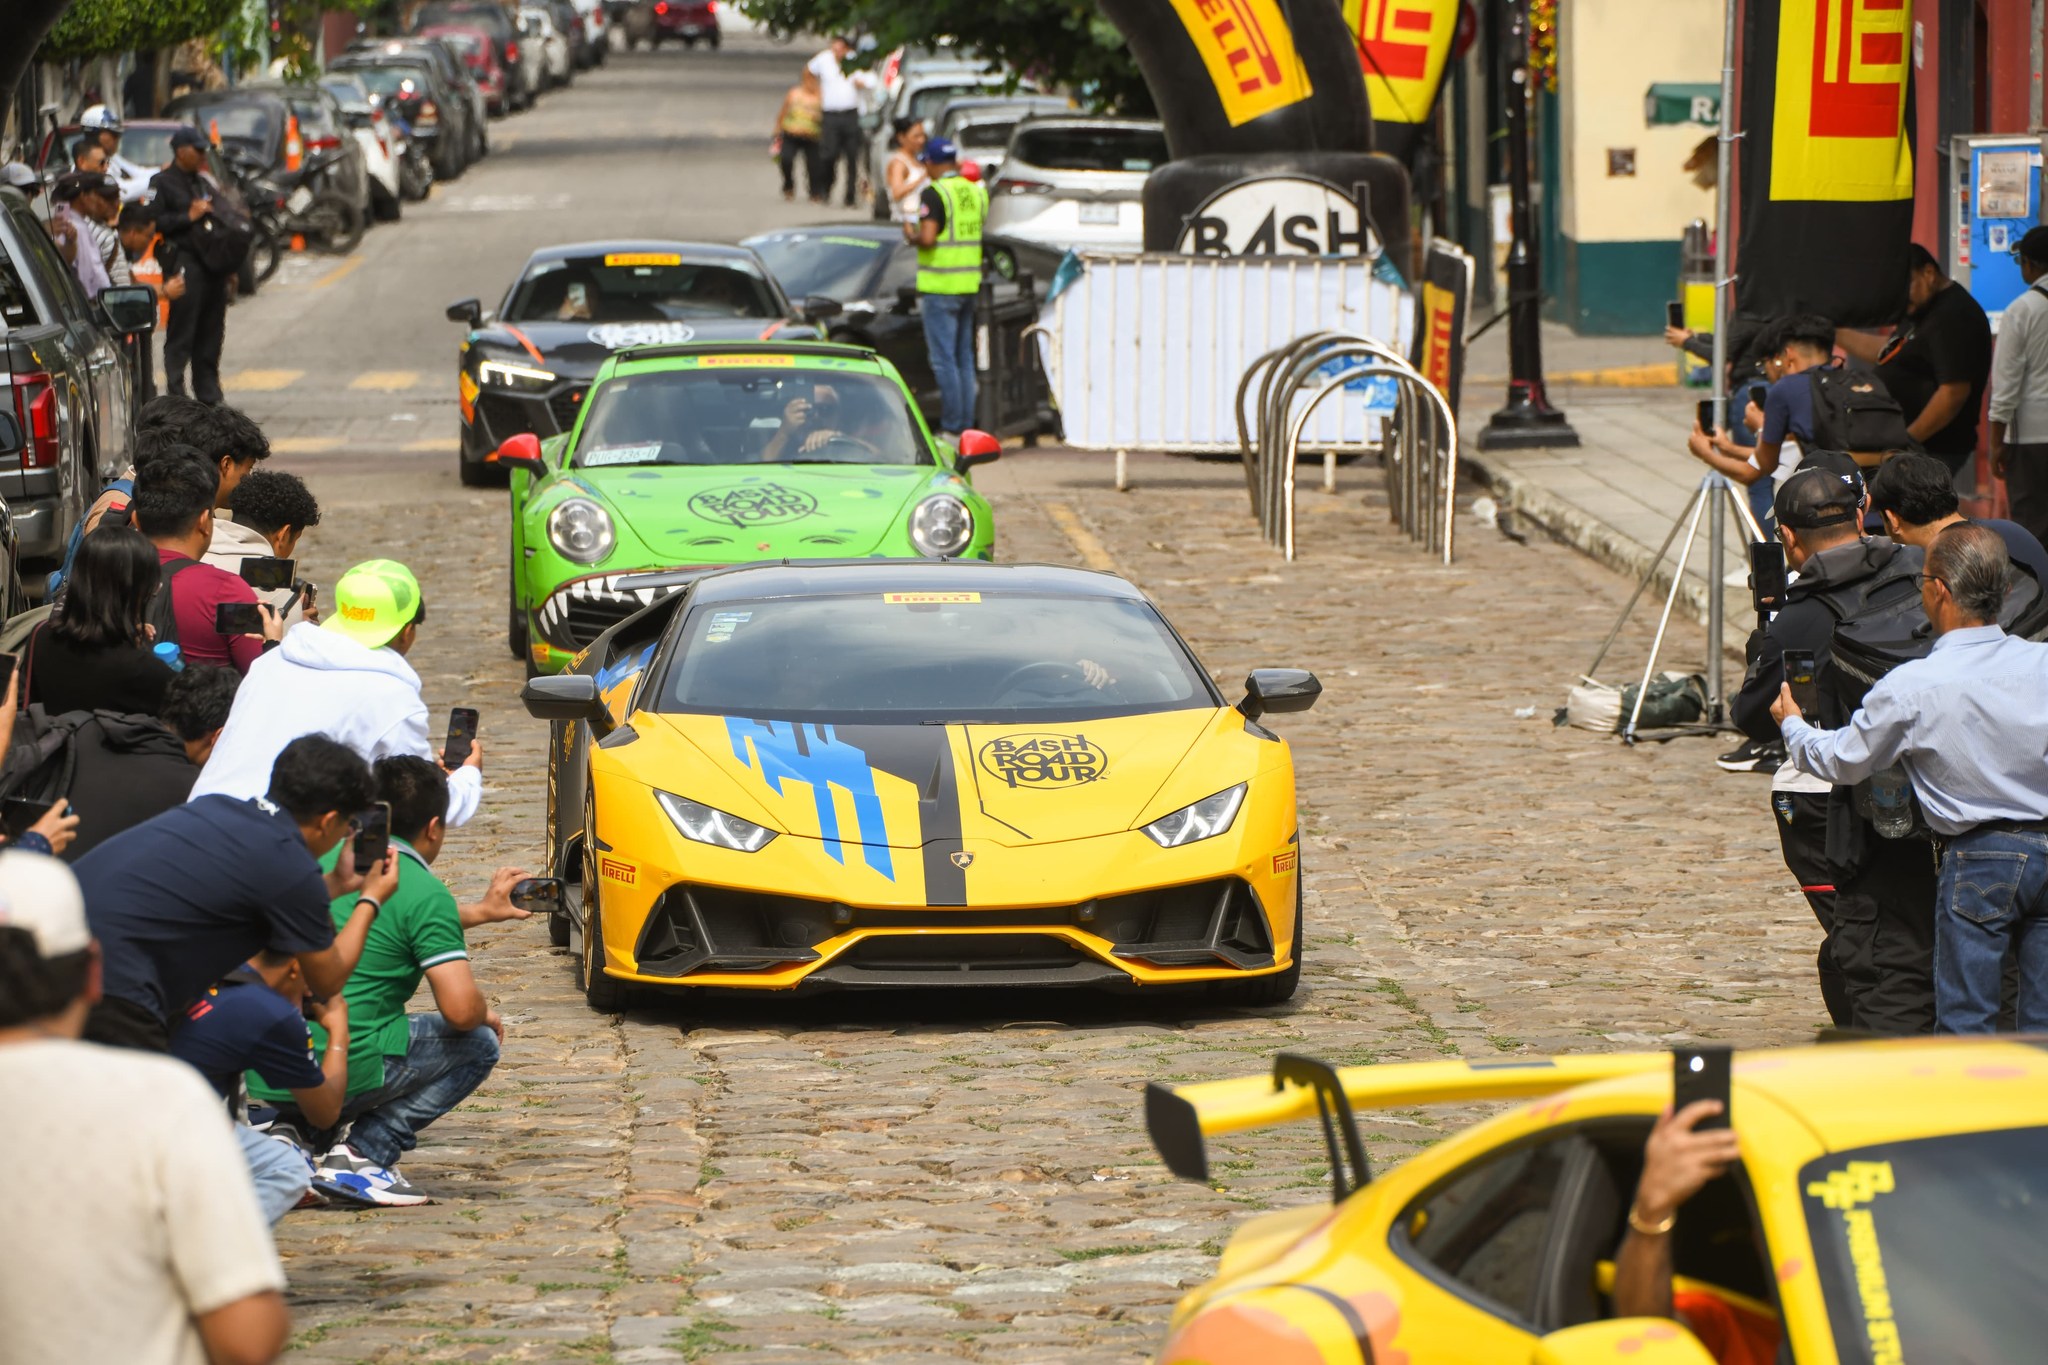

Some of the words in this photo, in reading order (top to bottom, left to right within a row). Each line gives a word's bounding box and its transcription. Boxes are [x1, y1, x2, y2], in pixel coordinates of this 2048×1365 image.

[1185, 183, 1369, 256] BASH
[989, 734, 1089, 755] BASH
[993, 750, 1097, 769] ROAD
[999, 766, 1098, 789] TOUR
[602, 857, 636, 884] PIRELLI
[1273, 850, 1296, 874] PIRELLI
